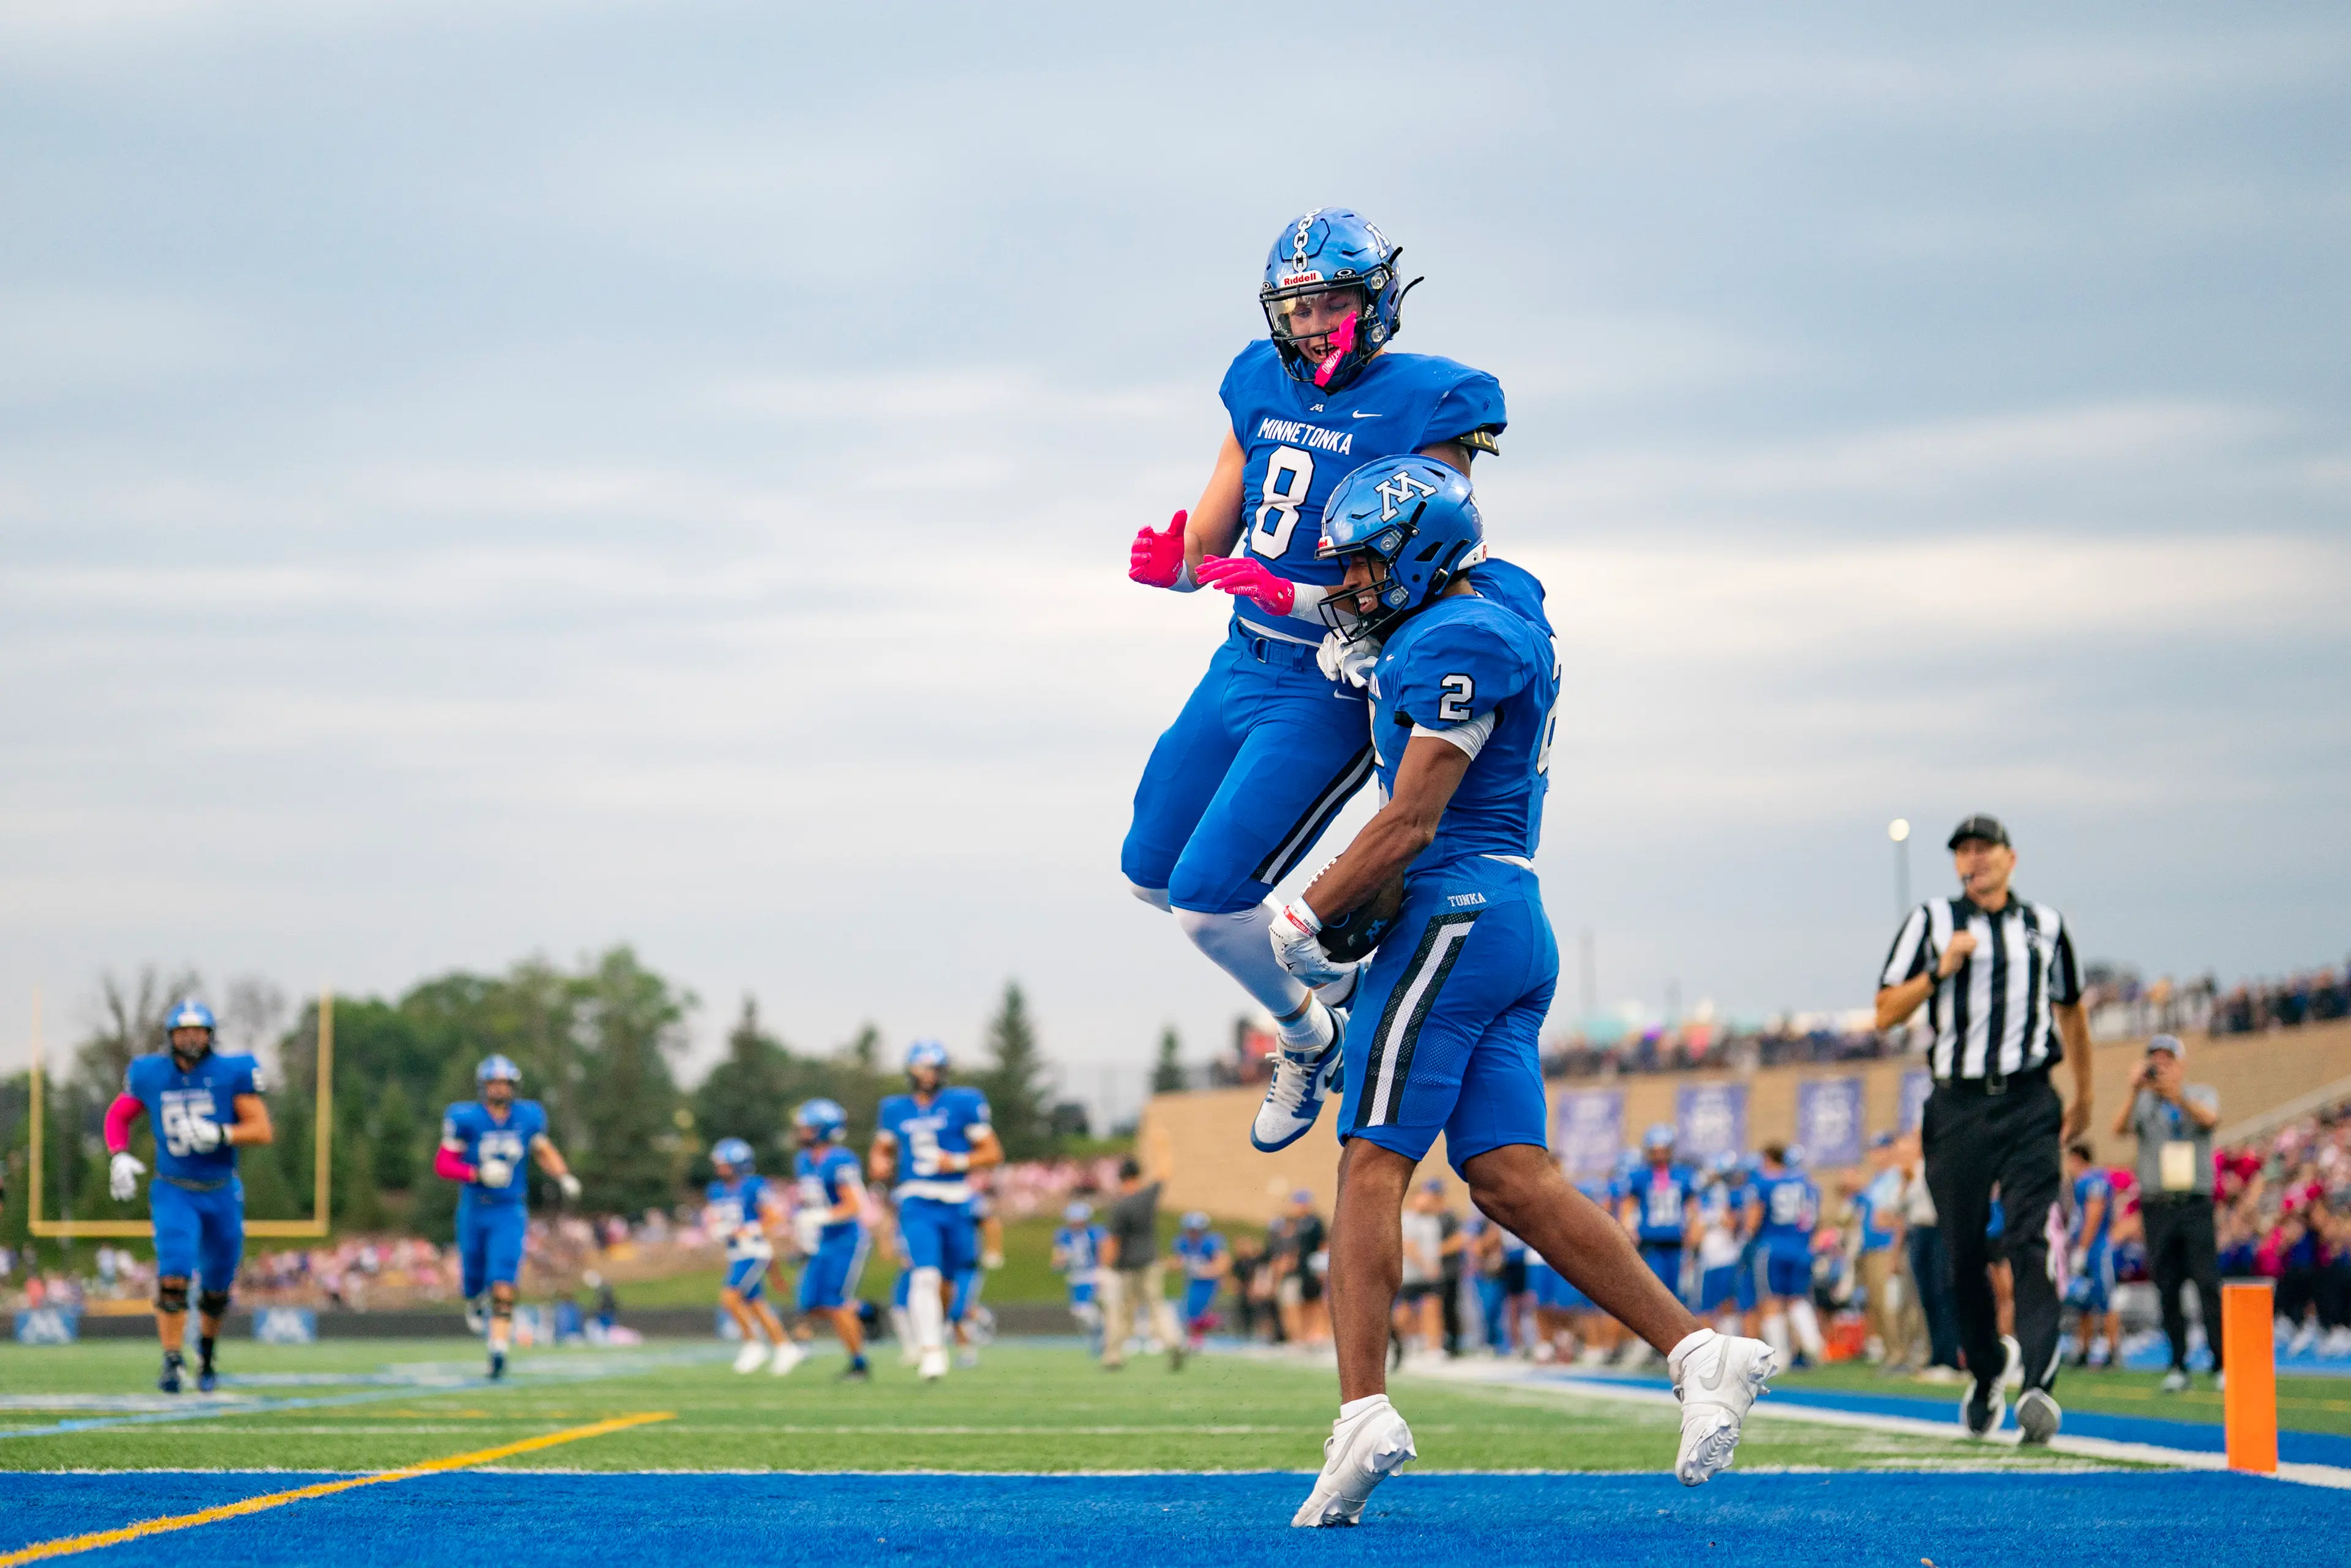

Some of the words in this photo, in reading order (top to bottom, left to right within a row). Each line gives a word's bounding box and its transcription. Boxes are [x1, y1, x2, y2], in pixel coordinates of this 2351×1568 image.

[1284, 272, 1316, 286] Riddell
[1257, 418, 1353, 455] MINNETONKA
[1250, 443, 1316, 561] 8
[1373, 470, 1438, 523] M
[1438, 673, 1475, 722] 2
[1447, 892, 1487, 907] TONKA
